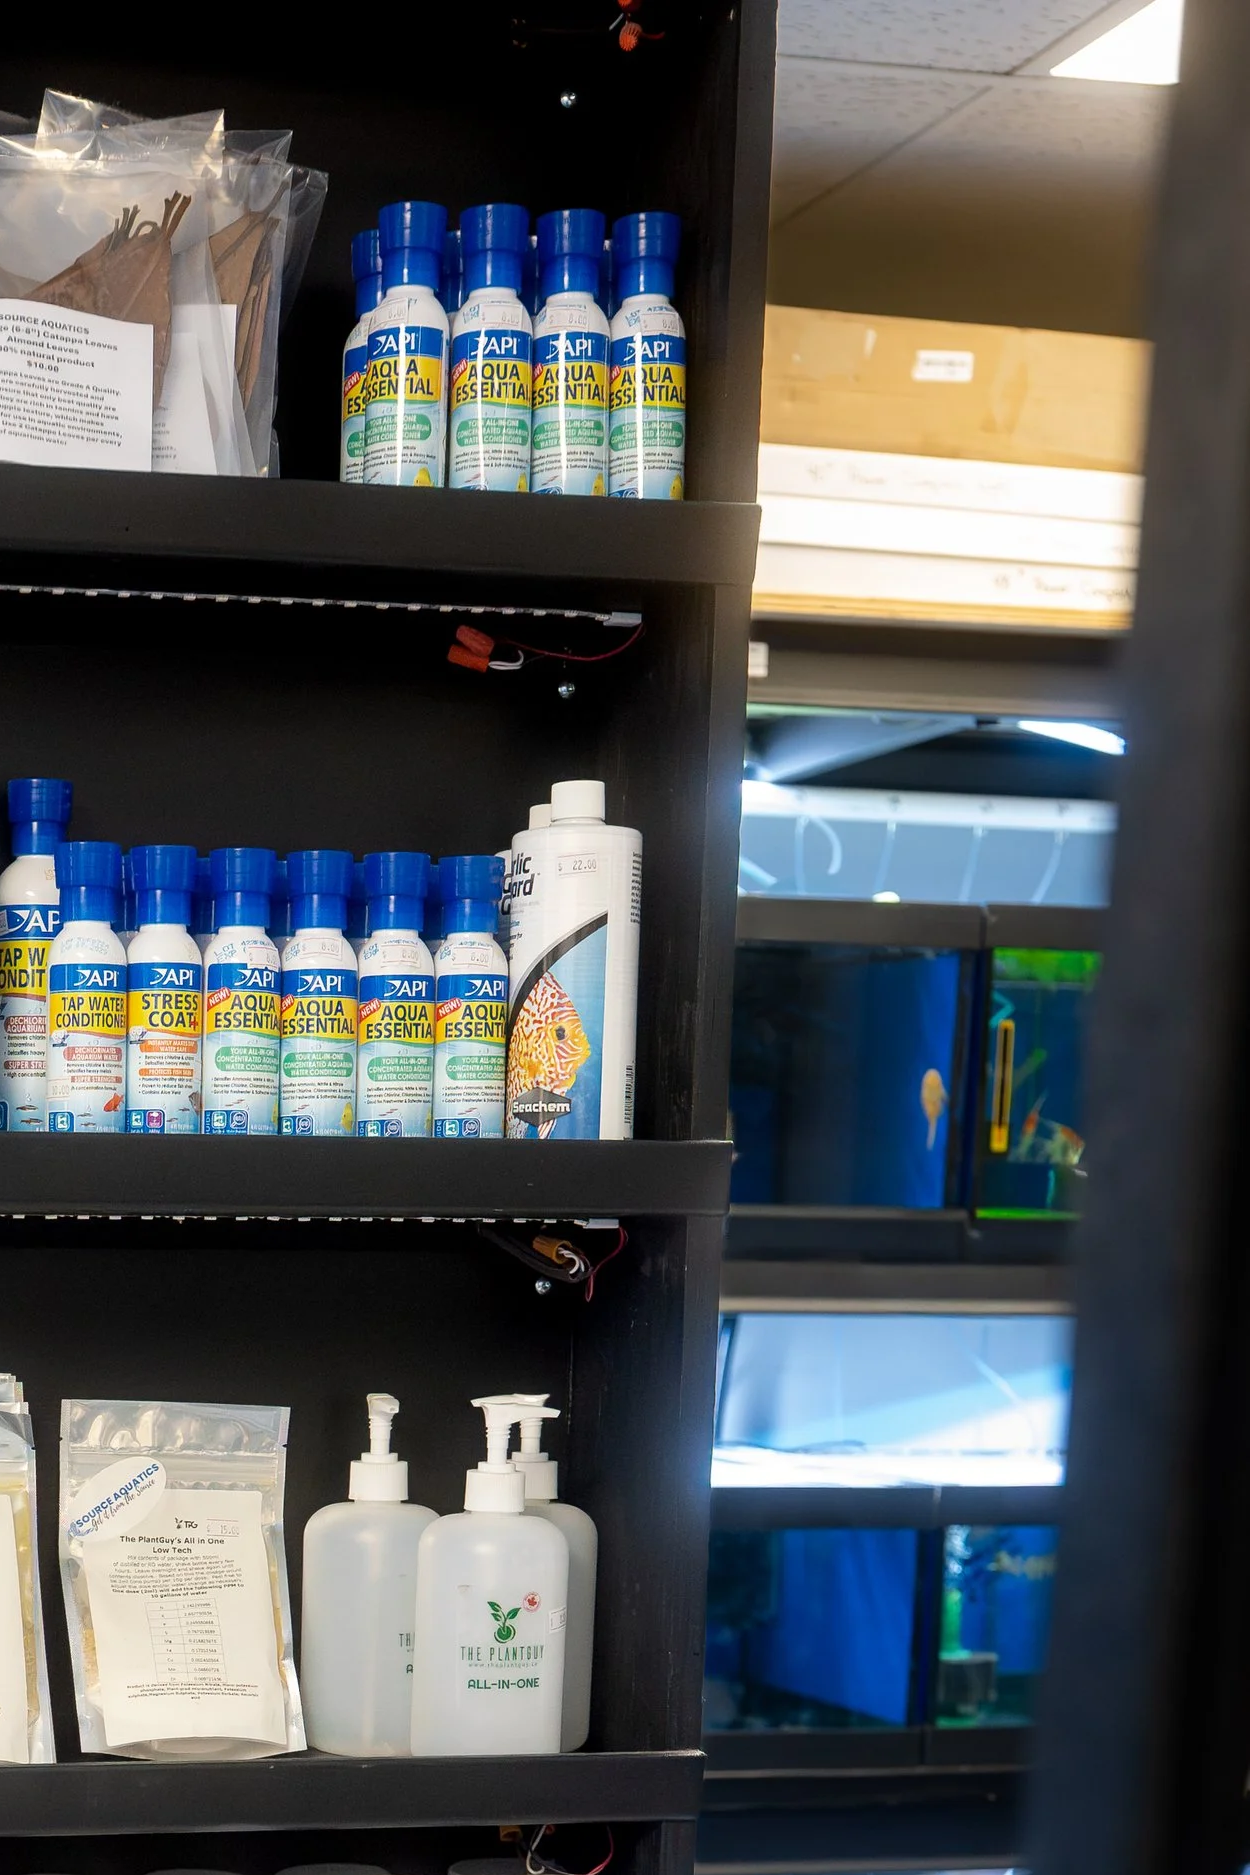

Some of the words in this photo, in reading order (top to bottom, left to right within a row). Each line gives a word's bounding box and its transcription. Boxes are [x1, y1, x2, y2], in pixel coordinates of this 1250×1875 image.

[41, 319, 89, 334] AQUATICS
[7, 336, 44, 347] Almond
[47, 342, 79, 354] Leaves
[43, 331, 83, 344] Catappa
[86, 337, 118, 350] Leaves
[483, 336, 517, 355] API
[565, 339, 592, 357] API
[641, 342, 669, 358] API
[20, 349, 55, 361] natural
[57, 355, 95, 369] product
[27, 360, 59, 372] $10.00
[468, 363, 520, 381] AQUA
[8, 430, 44, 441] aquarium
[573, 860, 597, 870] 22.00
[85, 971, 117, 986] API
[161, 970, 193, 985] API
[245, 971, 274, 987] API
[310, 976, 341, 992] API
[397, 981, 426, 997] API
[62, 997, 85, 1011] TAP
[142, 994, 198, 1010] STRESS
[230, 995, 276, 1012] AQUA
[295, 1000, 344, 1016] AQUA
[381, 1005, 428, 1022] AQUA
[462, 1005, 505, 1022] AQUA
[282, 1018, 354, 1035] ESSENTIAL
[513, 1100, 570, 1114] Seachem
[76, 1499, 112, 1528] SOURCE
[113, 1463, 159, 1501] AQUATICS
[138, 1536, 182, 1546] PlantGuy's
[460, 1646, 485, 1660] THE
[490, 1646, 544, 1660] PLANTGUY
[468, 1678, 540, 1690] ALL-IN-ONE
